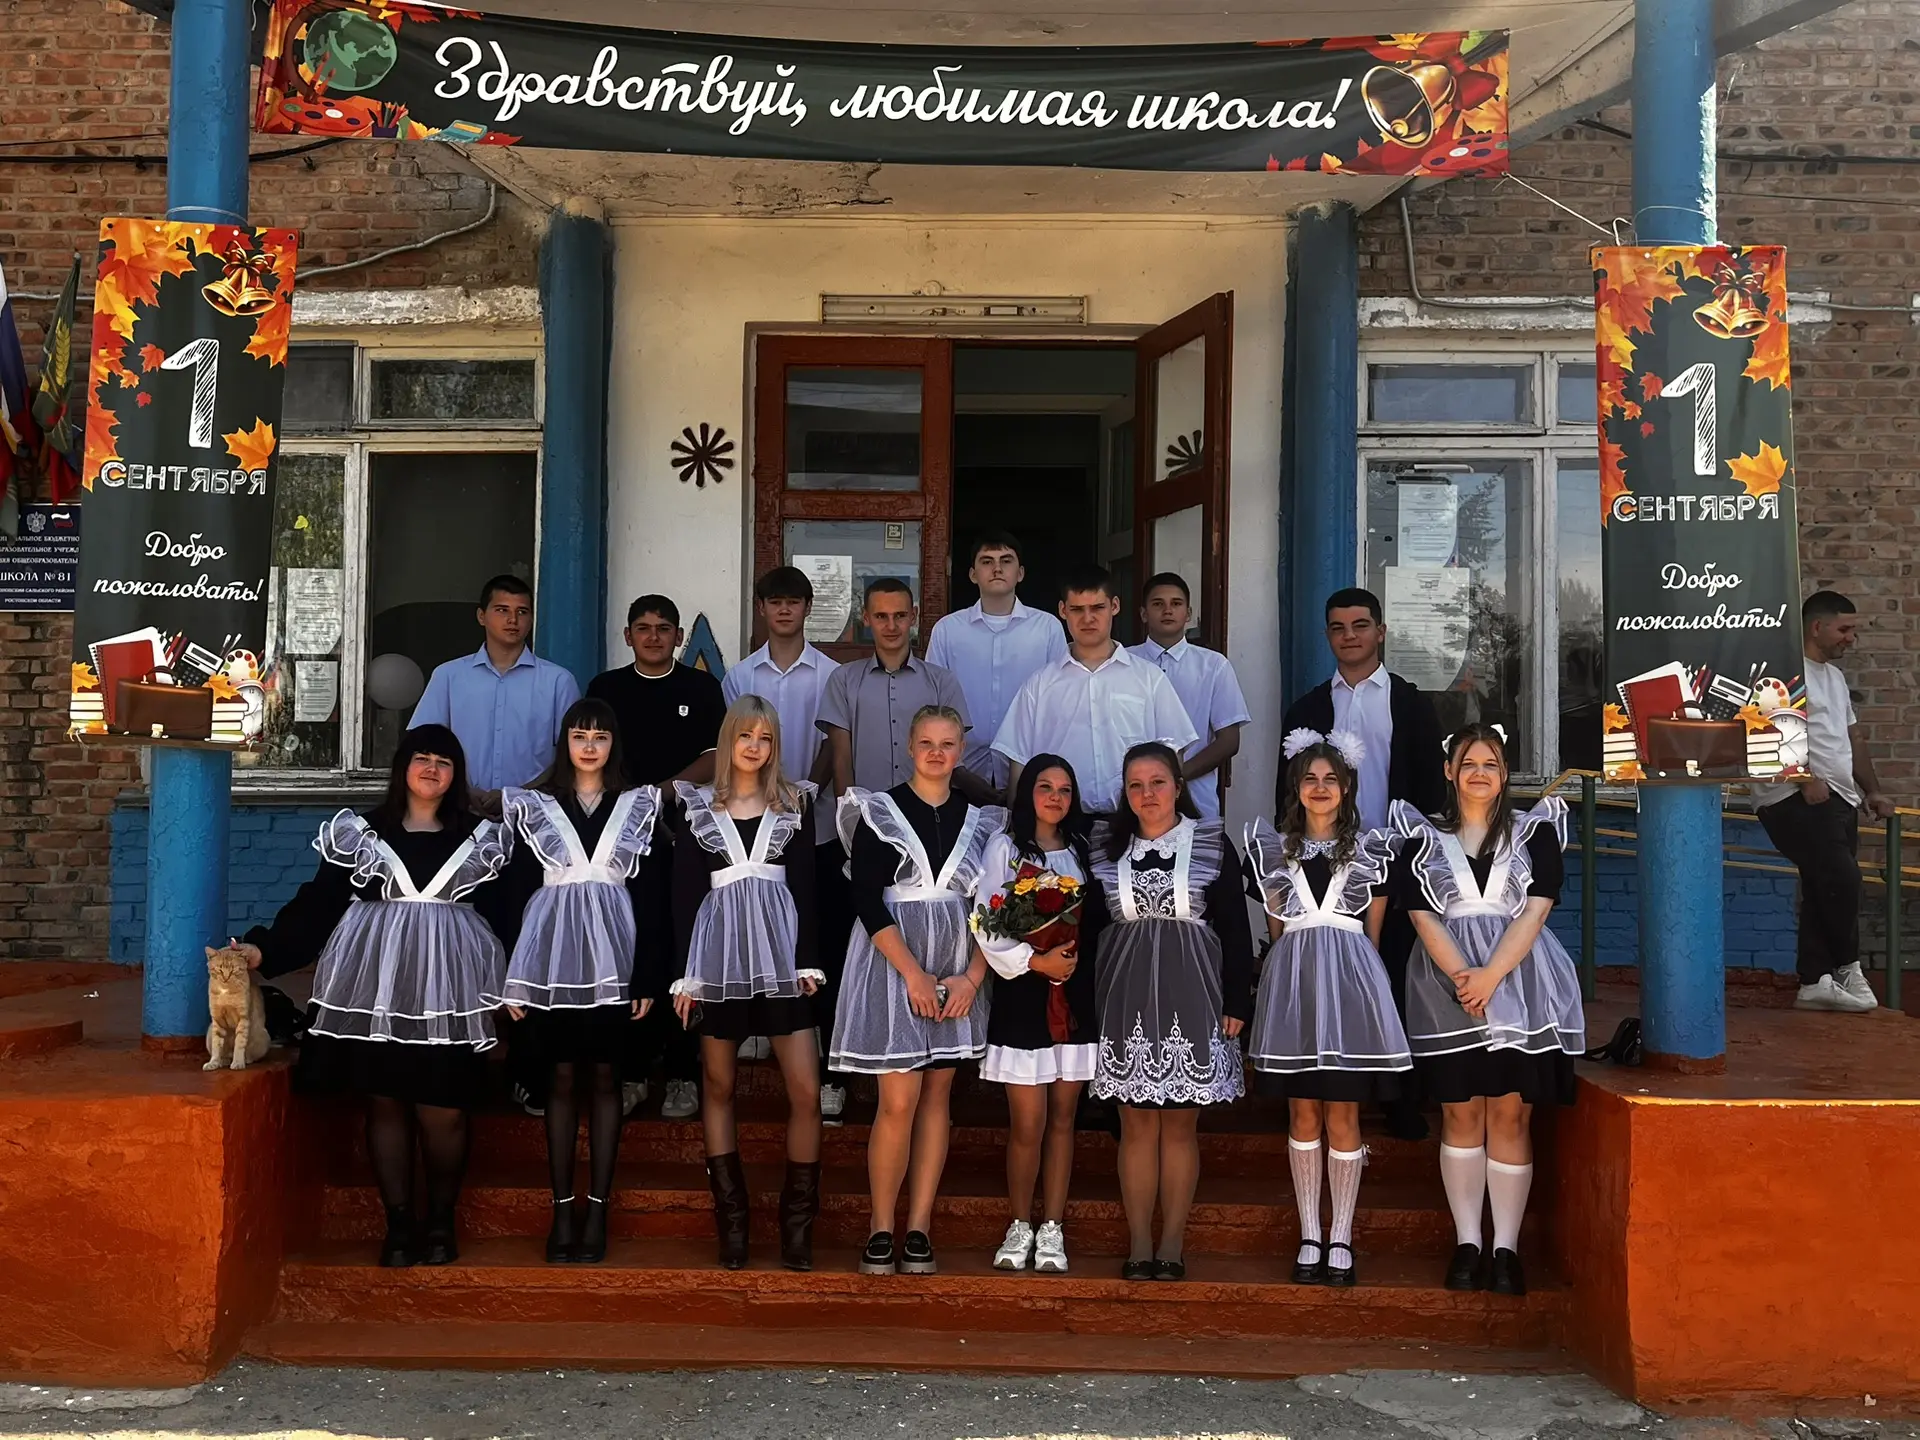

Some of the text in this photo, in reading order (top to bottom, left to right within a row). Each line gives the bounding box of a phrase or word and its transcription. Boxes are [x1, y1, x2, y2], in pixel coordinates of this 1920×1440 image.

[432, 36, 1353, 136] Здравствуй, любимая школа!
[160, 338, 220, 449] 1
[1659, 362, 1717, 476] 1
[100, 461, 266, 495] СЕНТЯБРЯ
[1612, 493, 1780, 522] СЕНТЯБРЯ
[144, 531, 227, 567] Добро
[92, 573, 264, 602] пожаловать!
[1660, 562, 1743, 598] Добро
[1615, 603, 1788, 631] пожаловать!
